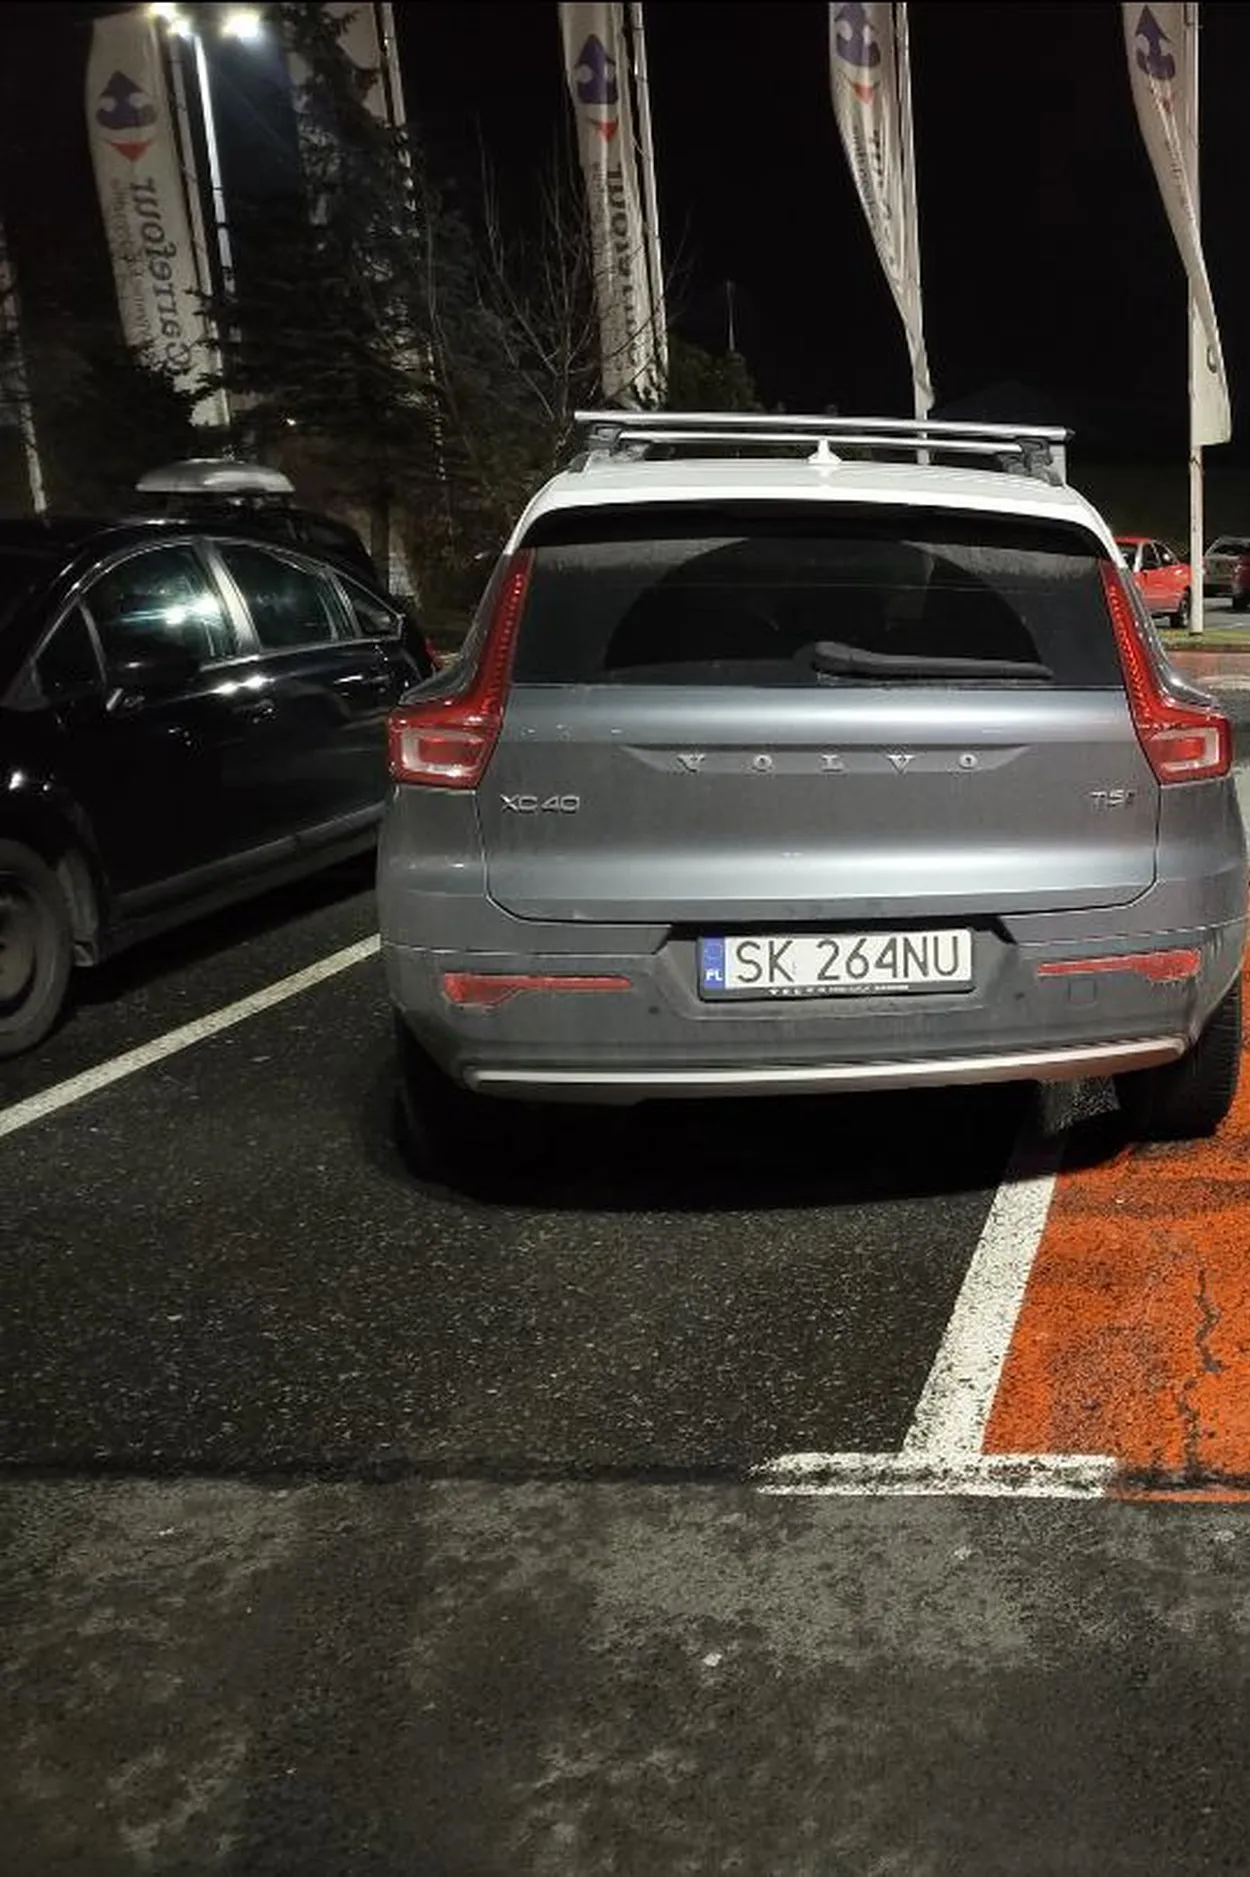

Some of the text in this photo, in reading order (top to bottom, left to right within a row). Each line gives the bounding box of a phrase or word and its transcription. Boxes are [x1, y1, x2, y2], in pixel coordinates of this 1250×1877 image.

[677, 753, 978, 773] VOLVO
[500, 794, 580, 811] XC40
[735, 935, 959, 983] SK 264NU
[705, 970, 723, 982] PL
